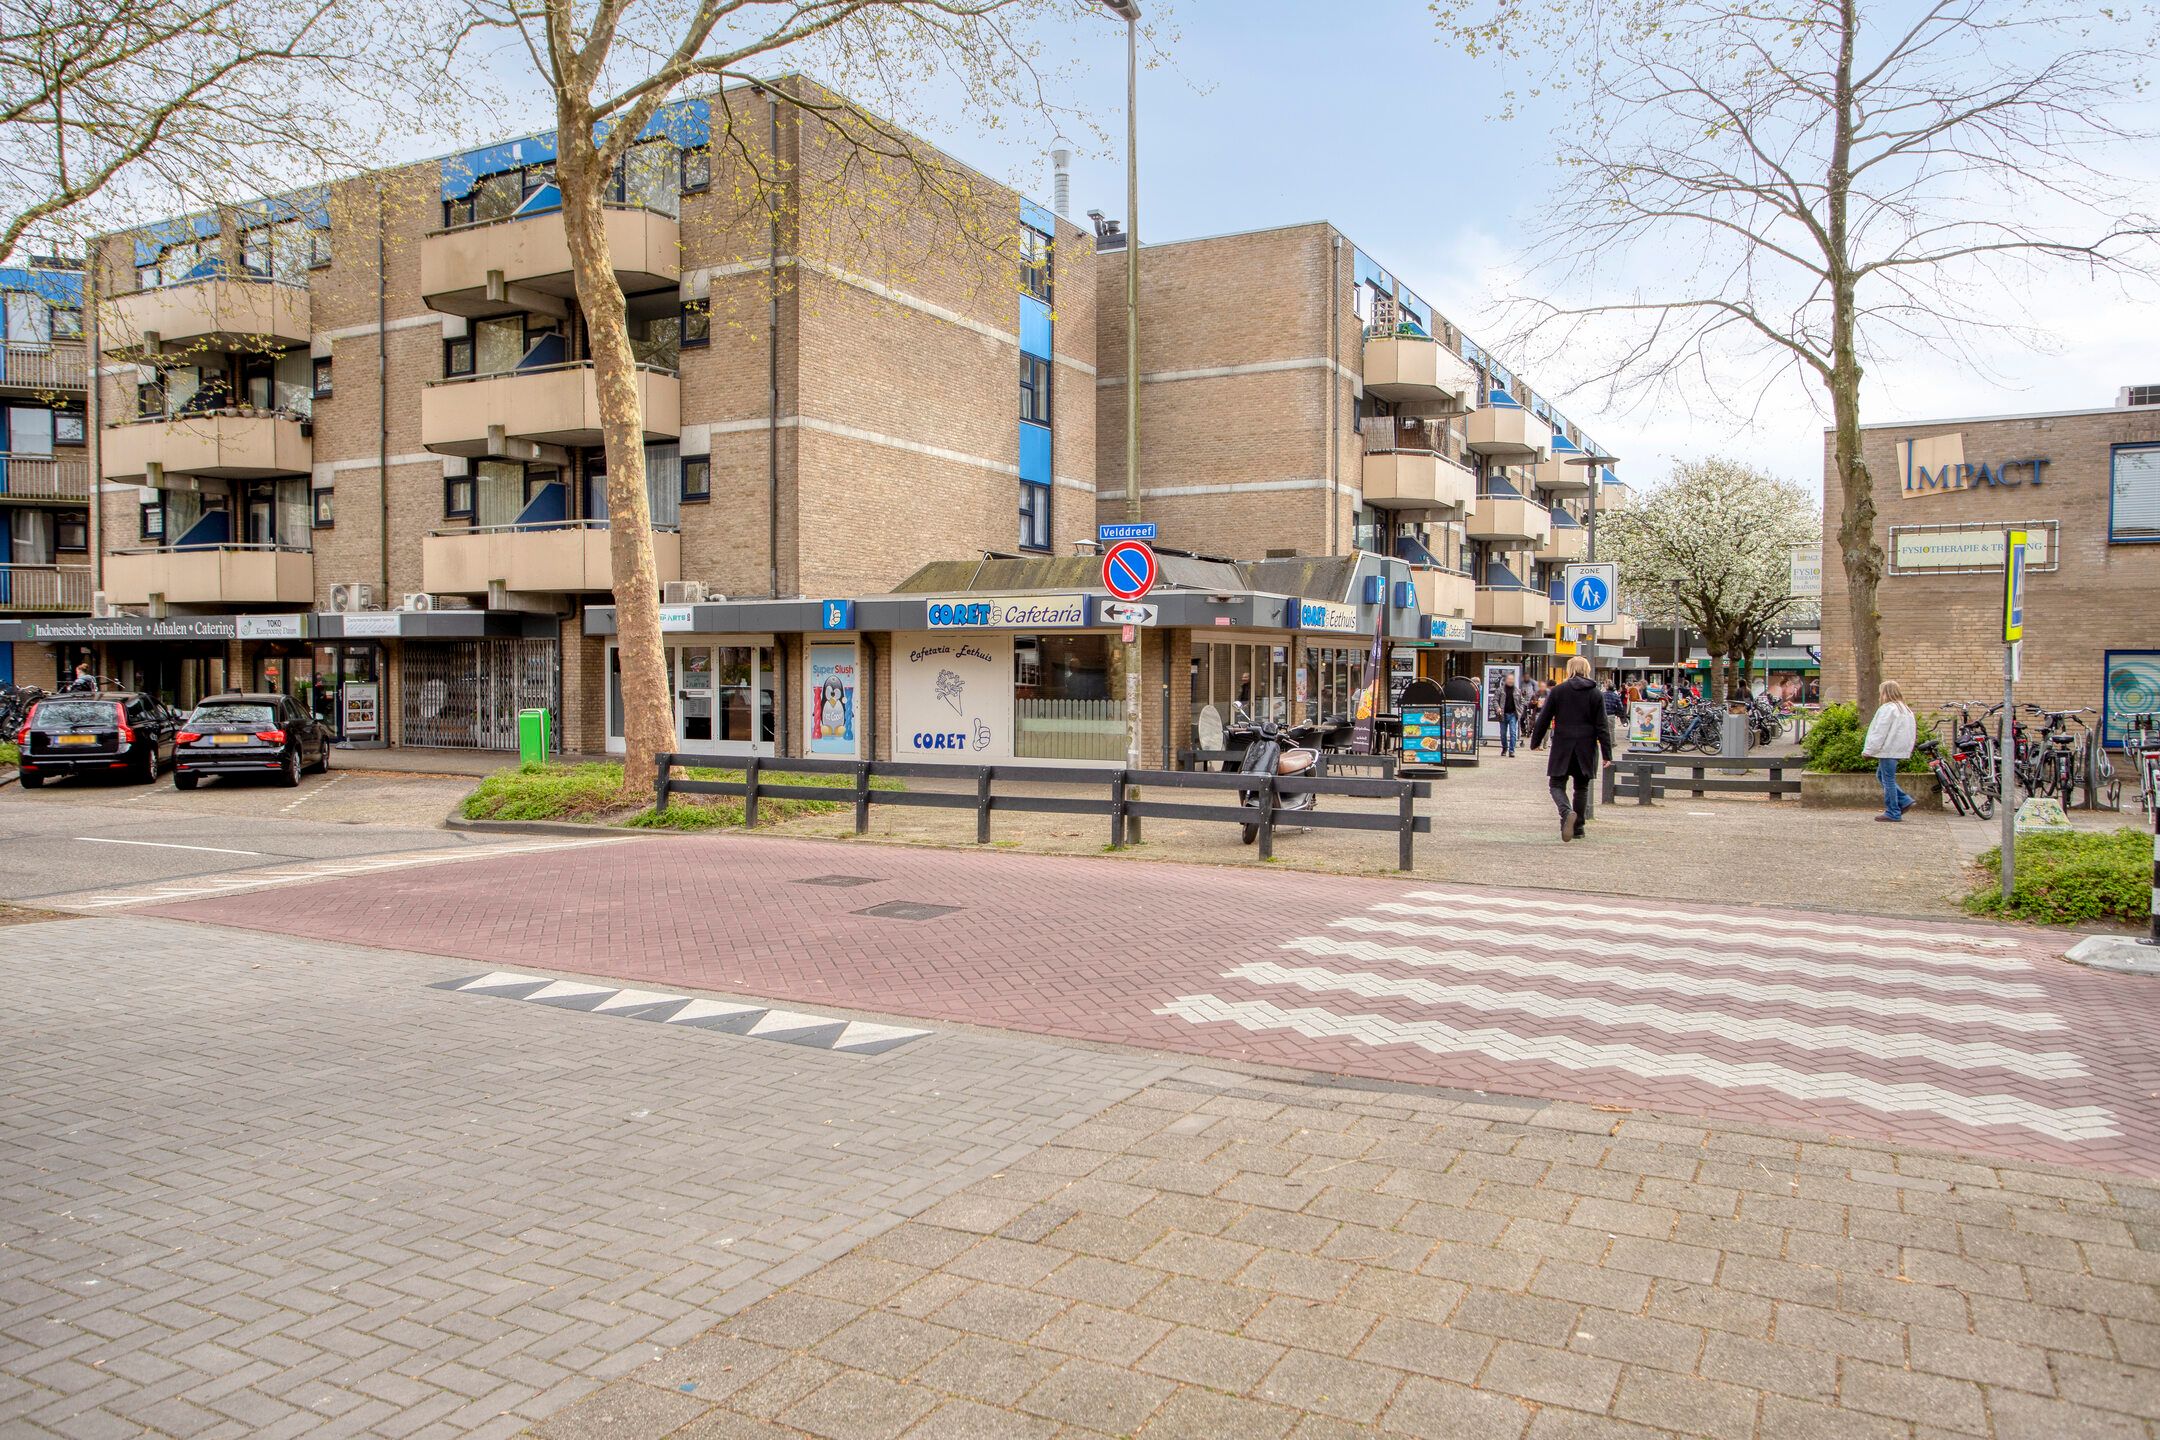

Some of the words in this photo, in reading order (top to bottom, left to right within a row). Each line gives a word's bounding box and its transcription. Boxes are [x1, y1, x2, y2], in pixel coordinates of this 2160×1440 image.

[1904, 437, 2050, 490] IMPACT
[1103, 526, 1152, 537] Velddreef
[1902, 543, 1978, 555] FYSIOTHERAPIE
[1981, 544, 1989, 552] &
[1991, 542, 2043, 551] TRNG
[1793, 568, 1820, 576] FYSIO
[929, 603, 991, 626] CORET
[1004, 603, 1082, 624] Cafetaria
[1302, 604, 1326, 627] CORET
[1330, 610, 1356, 628] Eethuis
[36, 623, 87, 637] Indonesische
[87, 622, 143, 639] Specialiteiten
[153, 621, 187, 636] Afhalen
[194, 621, 236, 639] Catering
[266, 619, 282, 628] TOKO
[910, 645, 950, 662] Cafetaria
[956, 645, 992, 662] Eethuis
[813, 664, 834, 675] Super
[834, 664, 854, 674] Slush
[913, 733, 966, 749] CORET
